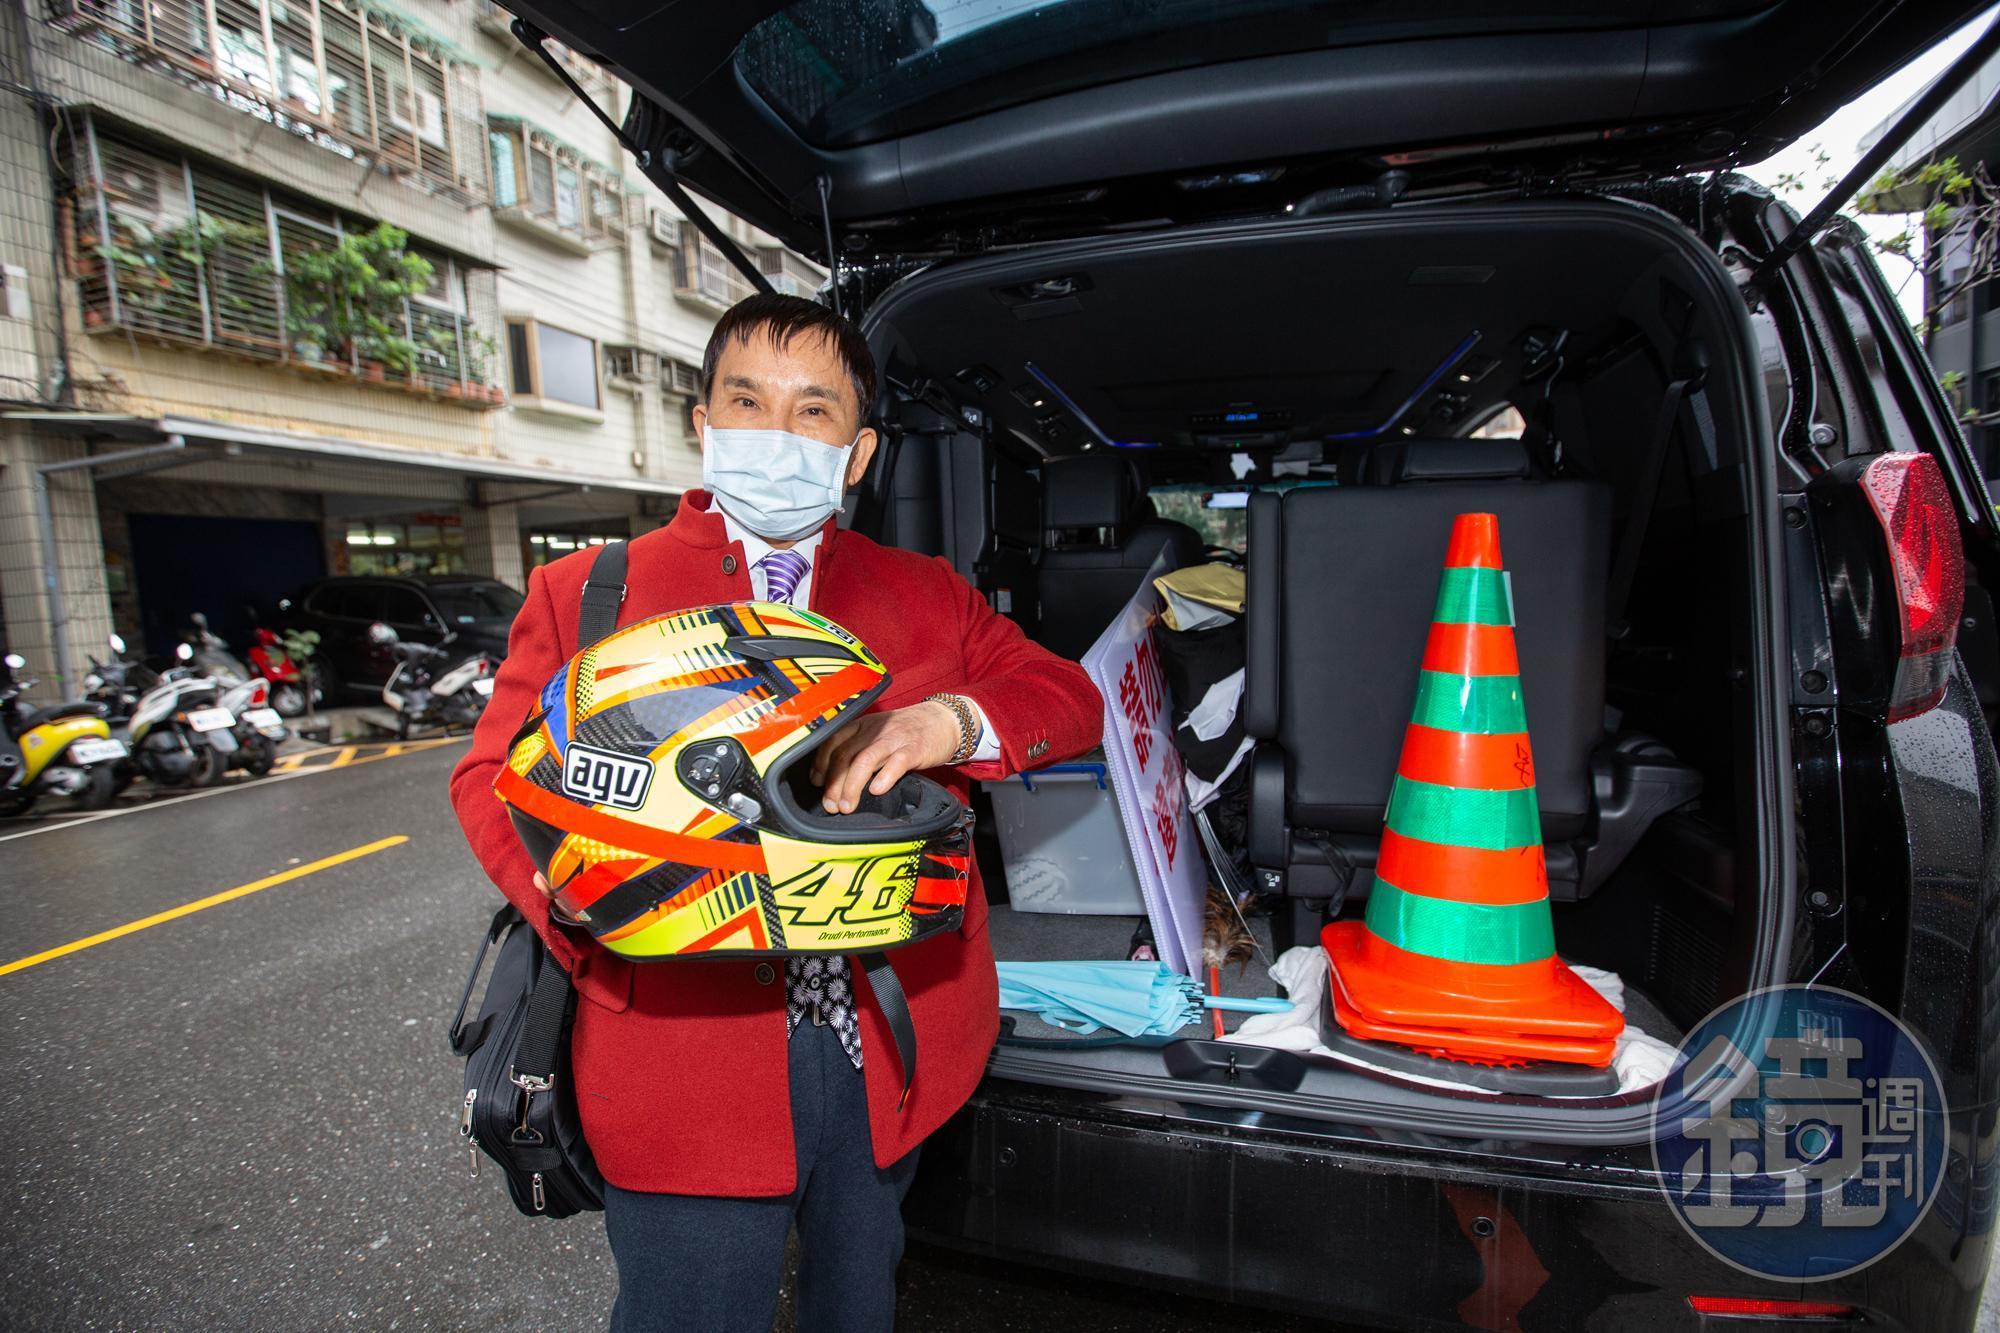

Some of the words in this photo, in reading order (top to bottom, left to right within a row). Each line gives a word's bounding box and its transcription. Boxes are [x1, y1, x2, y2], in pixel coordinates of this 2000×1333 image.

[572, 756, 641, 801] agv
[772, 851, 919, 926] 46
[817, 931, 842, 941] Drudi
[842, 927, 891, 940] Performance
